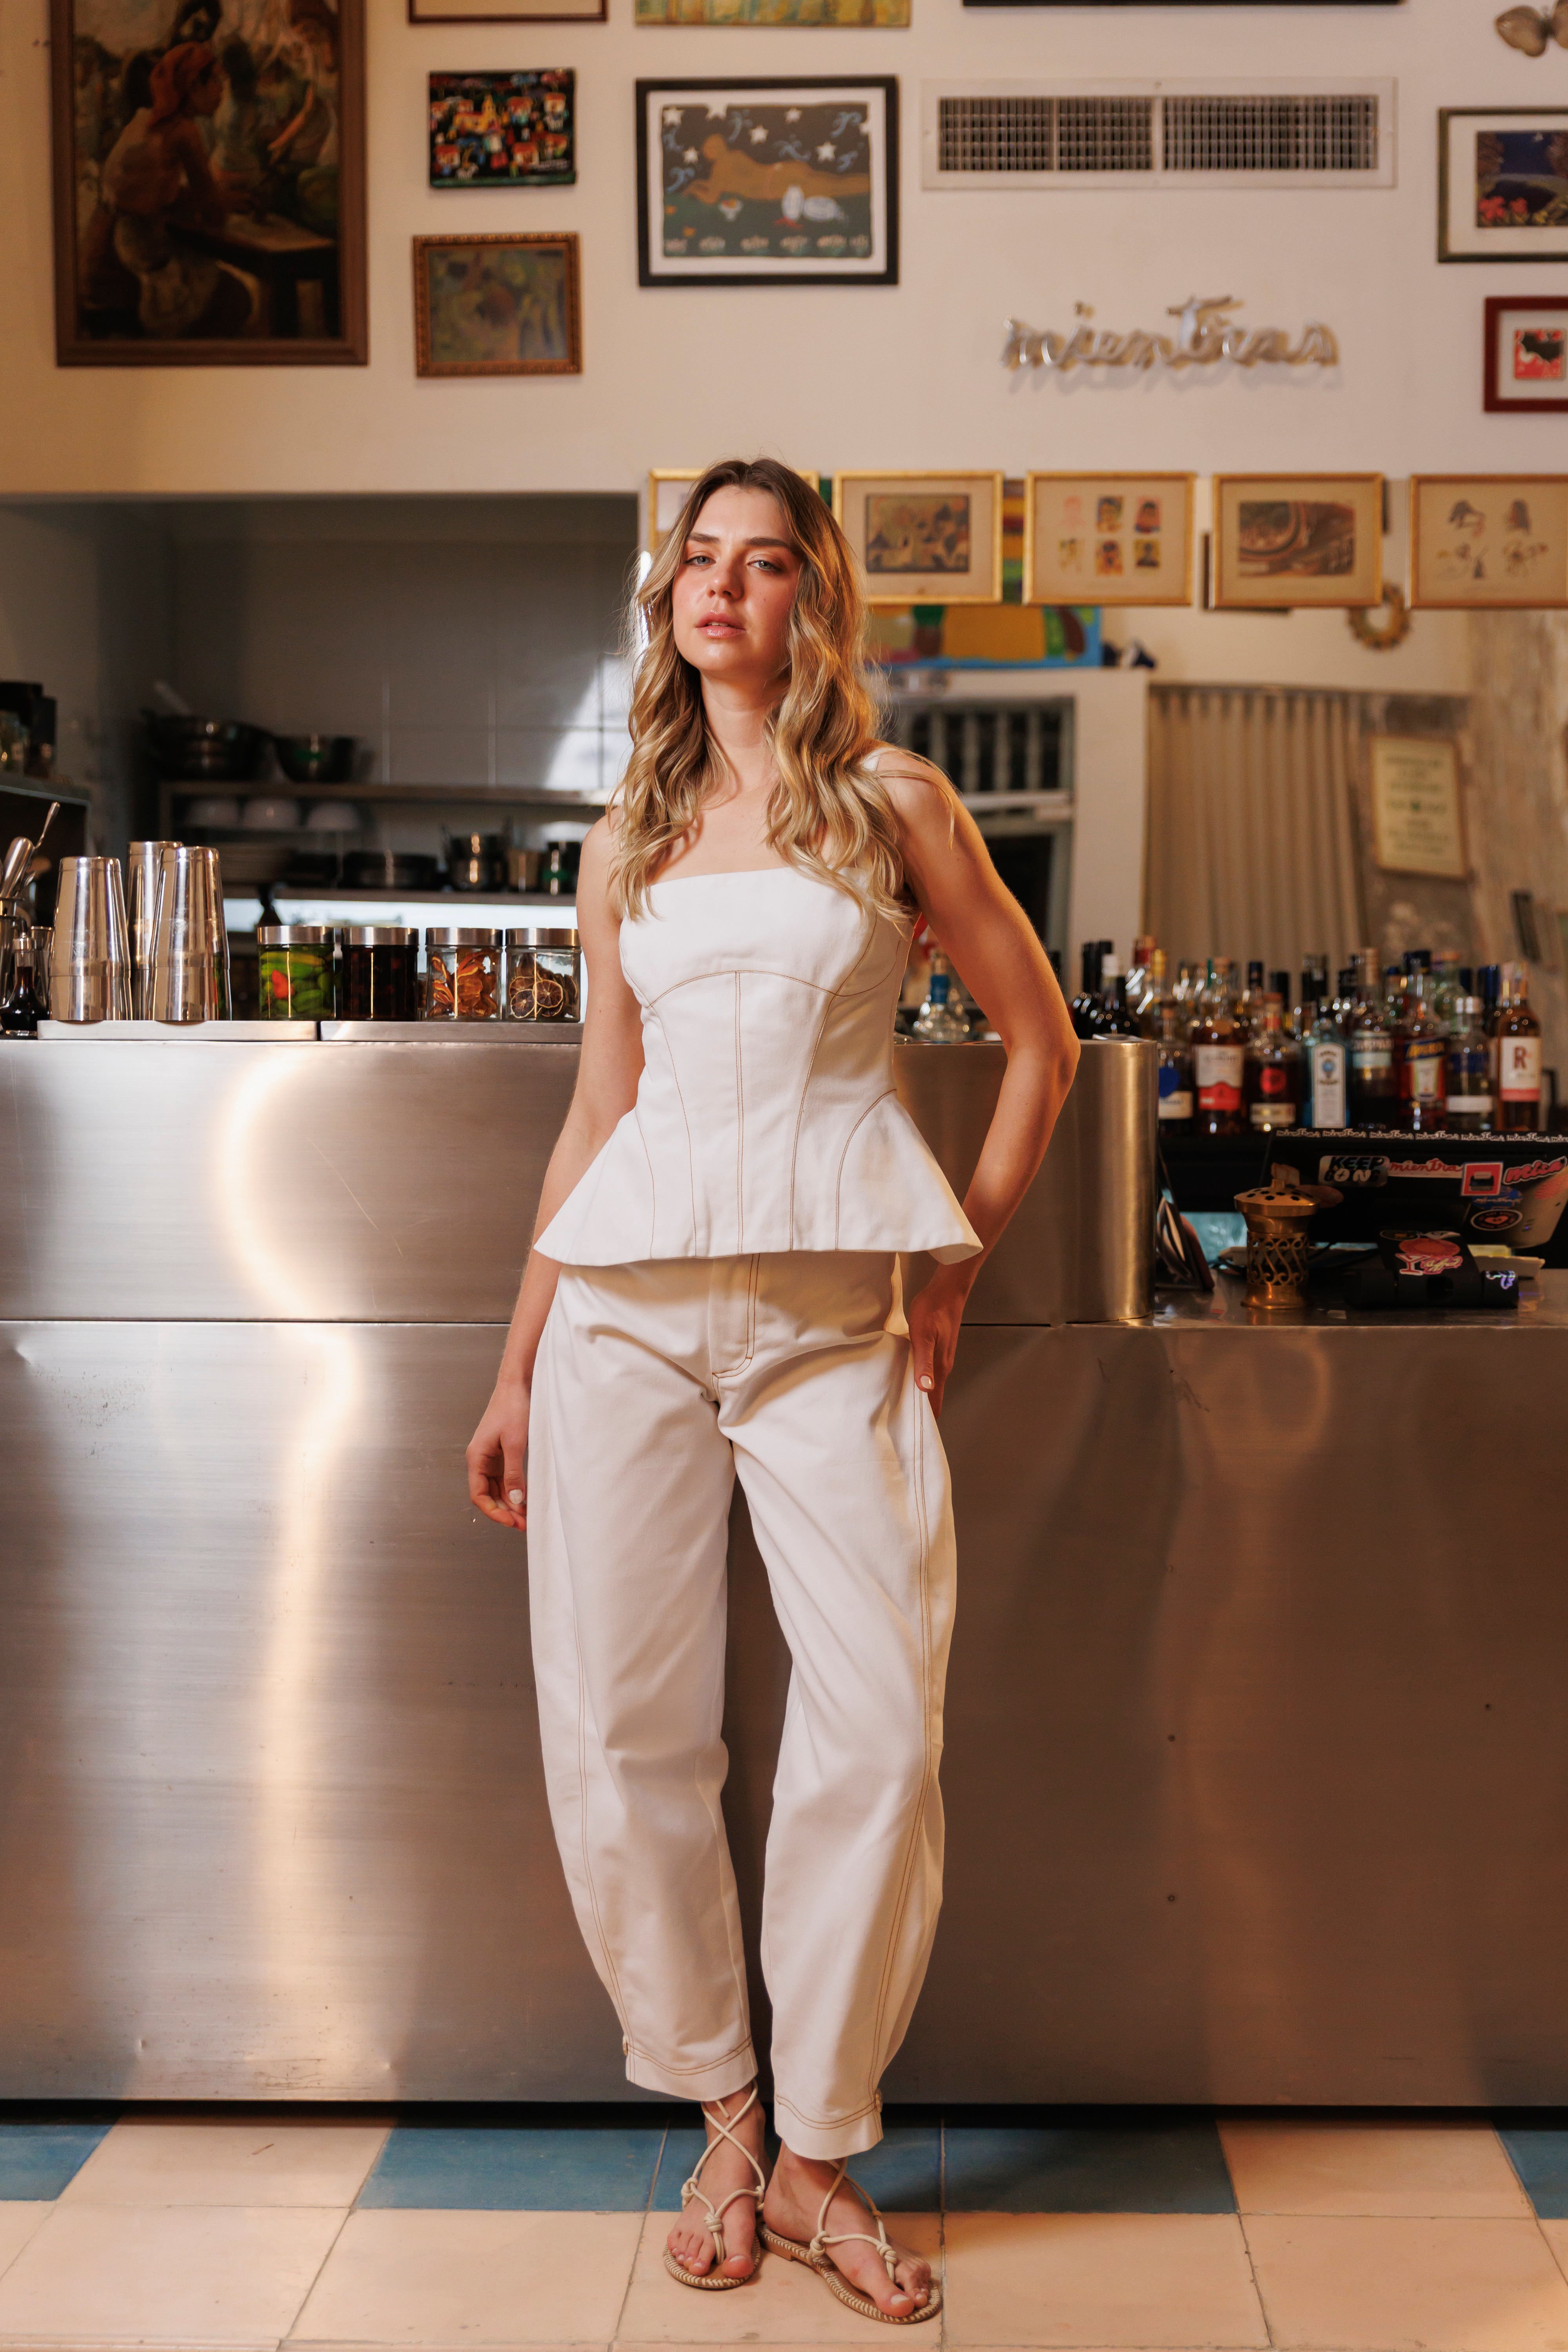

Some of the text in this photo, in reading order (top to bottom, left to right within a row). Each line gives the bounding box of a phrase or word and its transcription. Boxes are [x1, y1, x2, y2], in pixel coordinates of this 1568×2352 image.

[1000, 295, 1339, 368] mientras
[1513, 1045, 1528, 1069] R
[1329, 1156, 1385, 1171] KEEP
[1389, 1158, 1461, 1172] mientra
